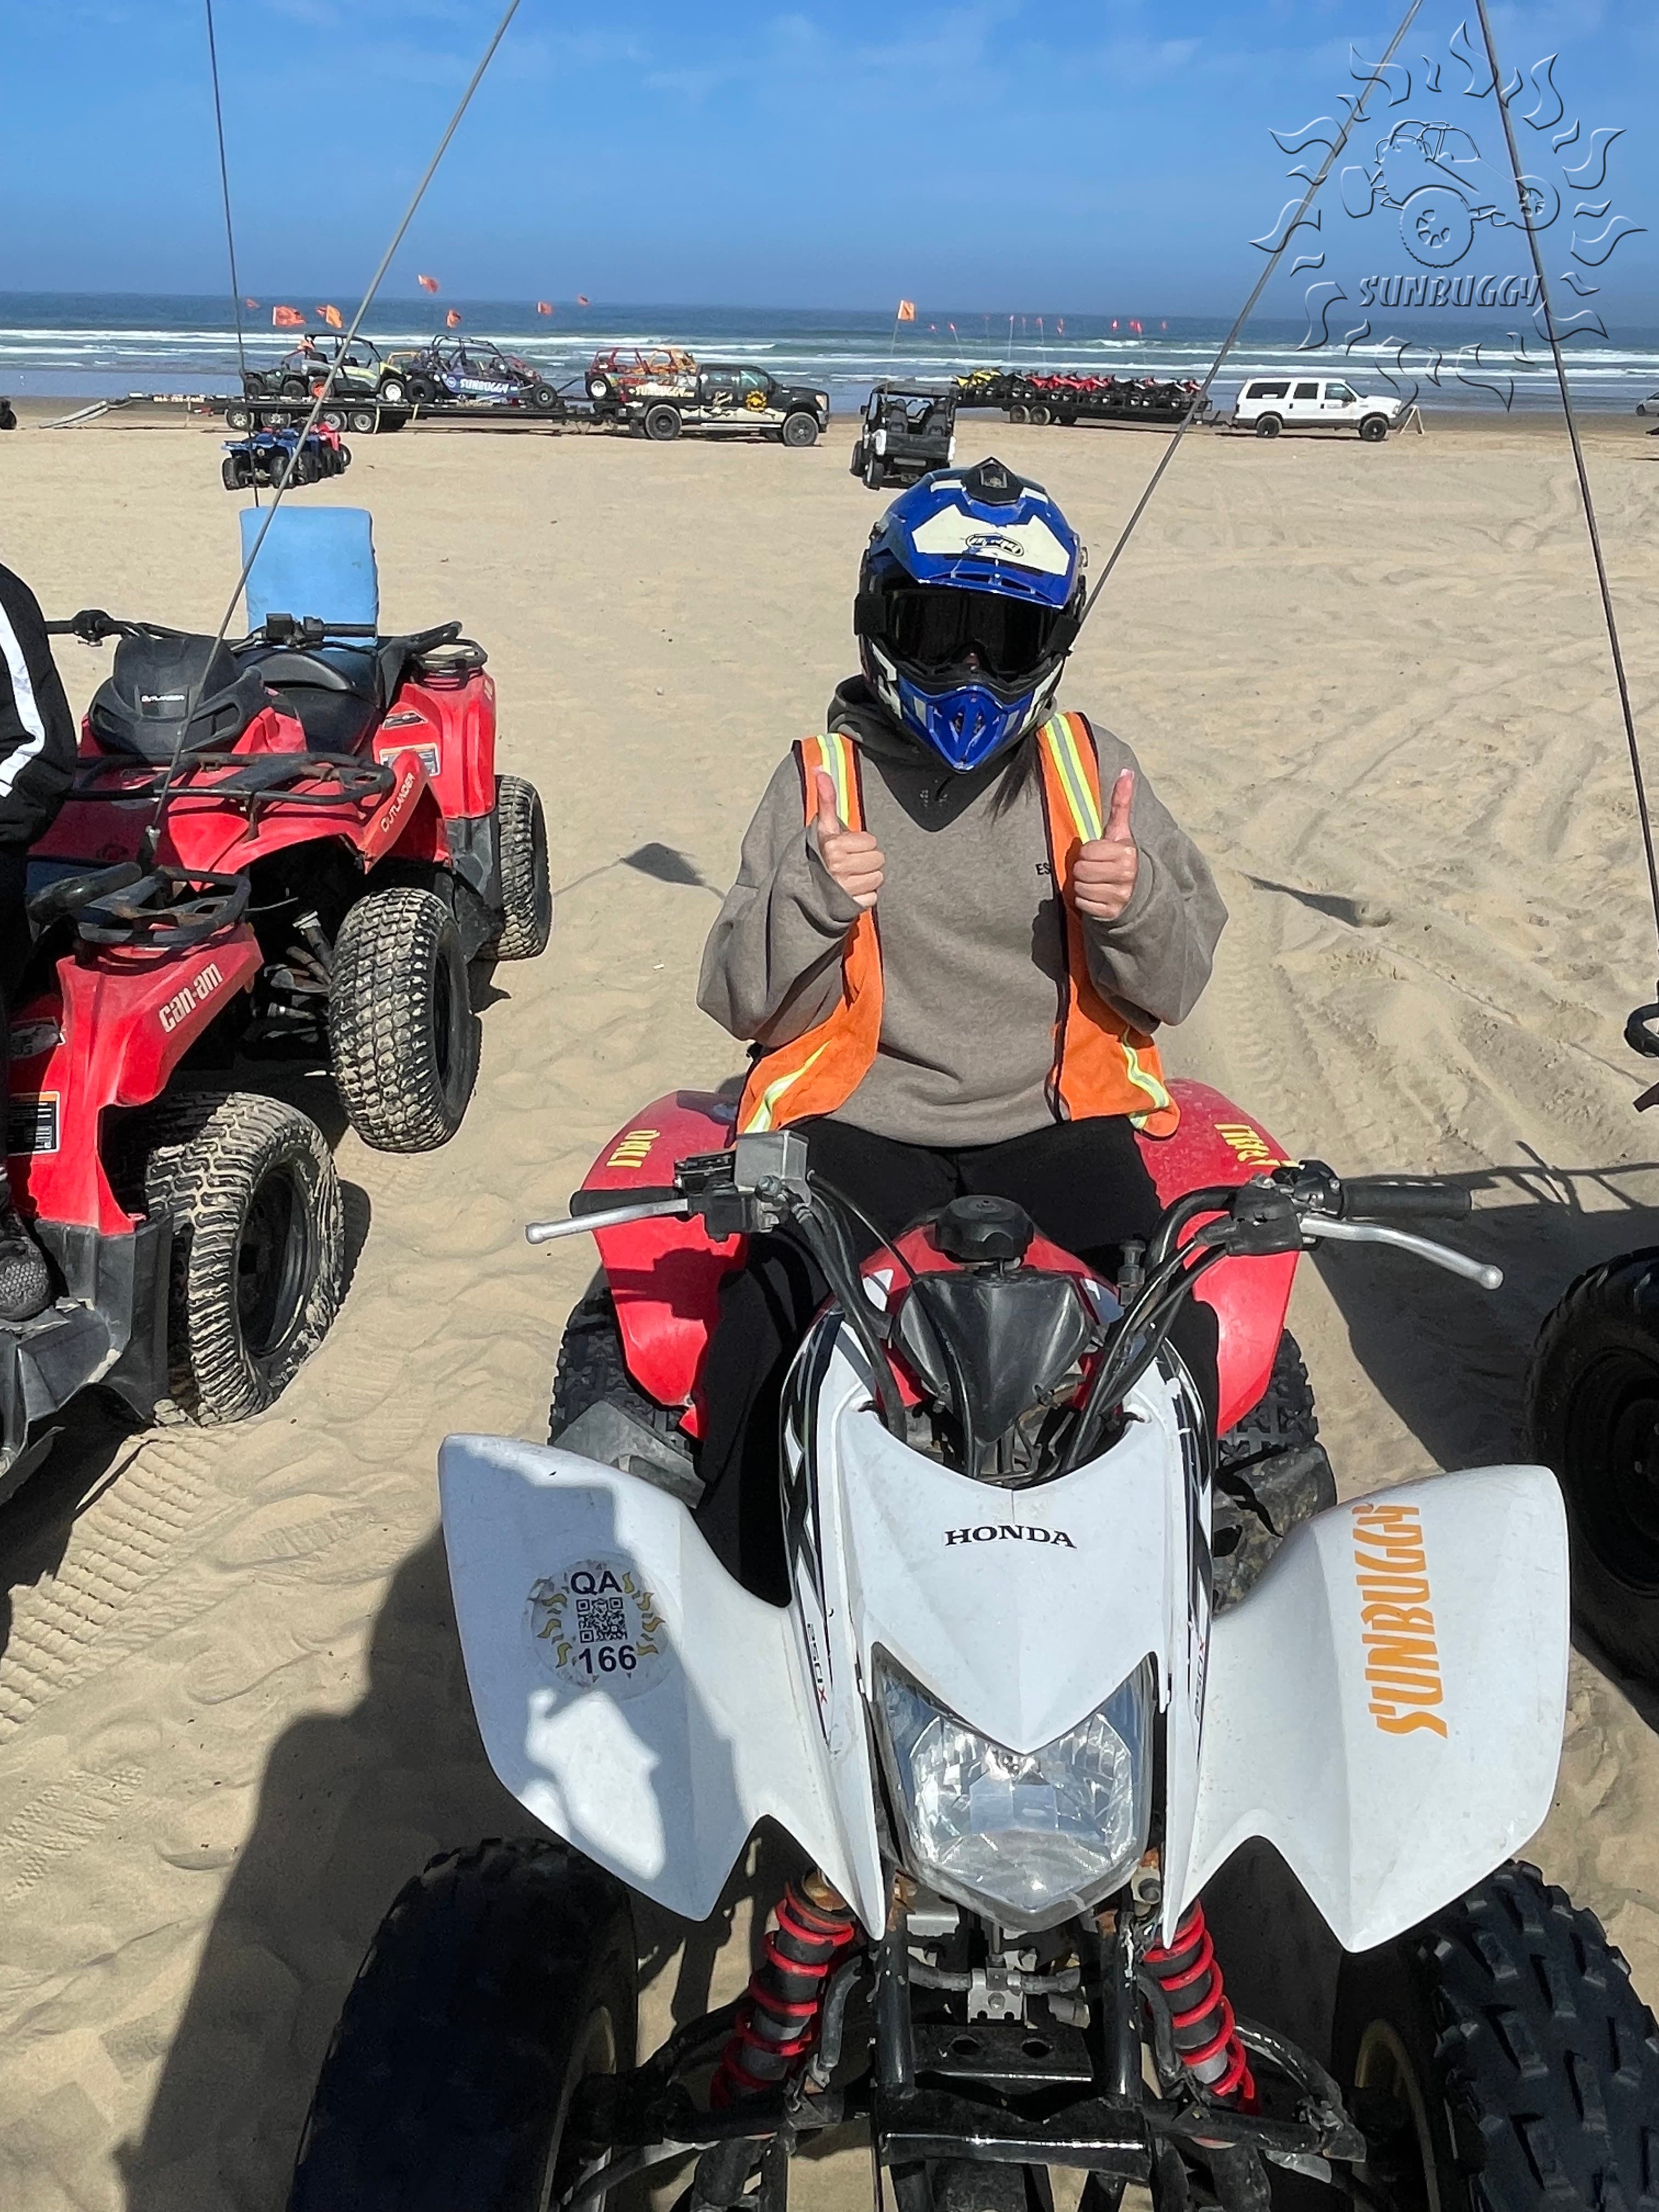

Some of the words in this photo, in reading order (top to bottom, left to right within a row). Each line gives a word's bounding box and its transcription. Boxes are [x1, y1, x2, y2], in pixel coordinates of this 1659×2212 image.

[944, 1524, 1077, 1549] HONDA
[571, 1570, 623, 1595] QA
[1351, 1503, 1448, 1739] SUNBUGGY
[578, 1645, 636, 1674] 166
